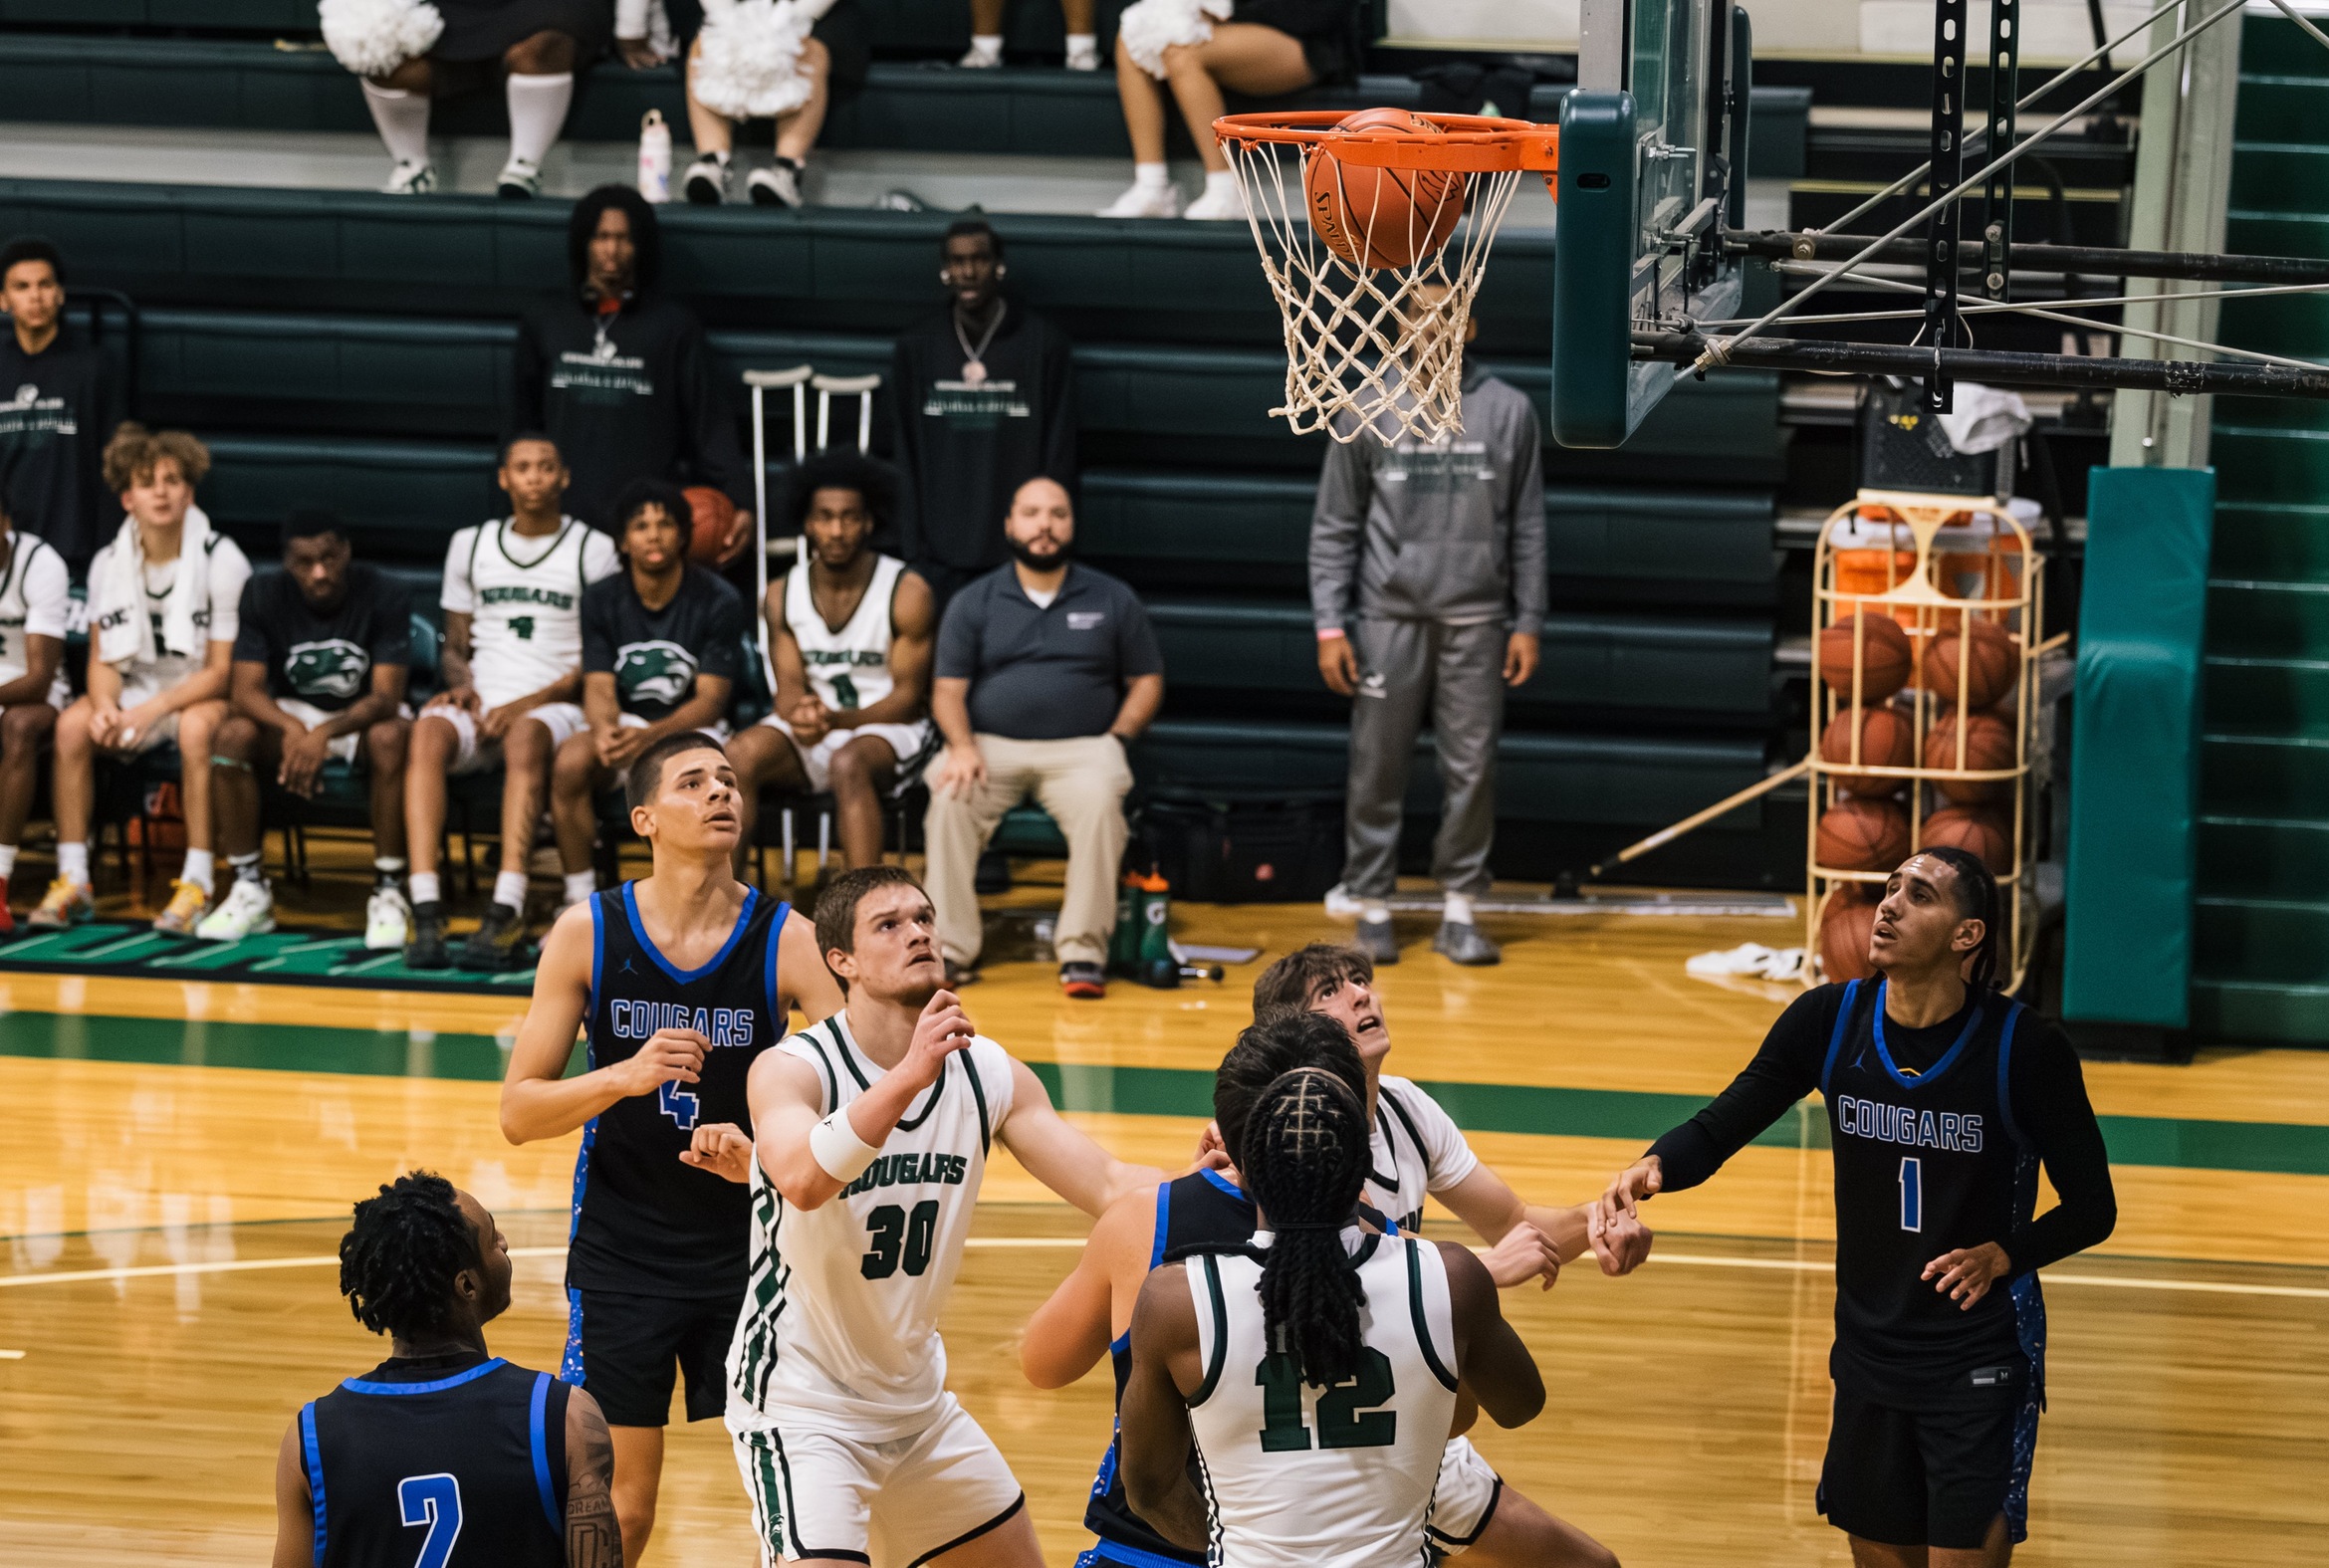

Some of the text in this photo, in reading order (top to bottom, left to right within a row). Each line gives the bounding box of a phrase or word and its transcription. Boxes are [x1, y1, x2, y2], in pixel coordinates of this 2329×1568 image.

[1314, 190, 1361, 265] SPALDI
[610, 999, 754, 1046] COUGARS
[658, 1079, 700, 1131] 4
[1838, 1094, 1983, 1153] COUGARS
[1898, 1156, 1922, 1233] 1
[860, 1200, 939, 1280] 30
[1255, 1346, 1397, 1453] 12
